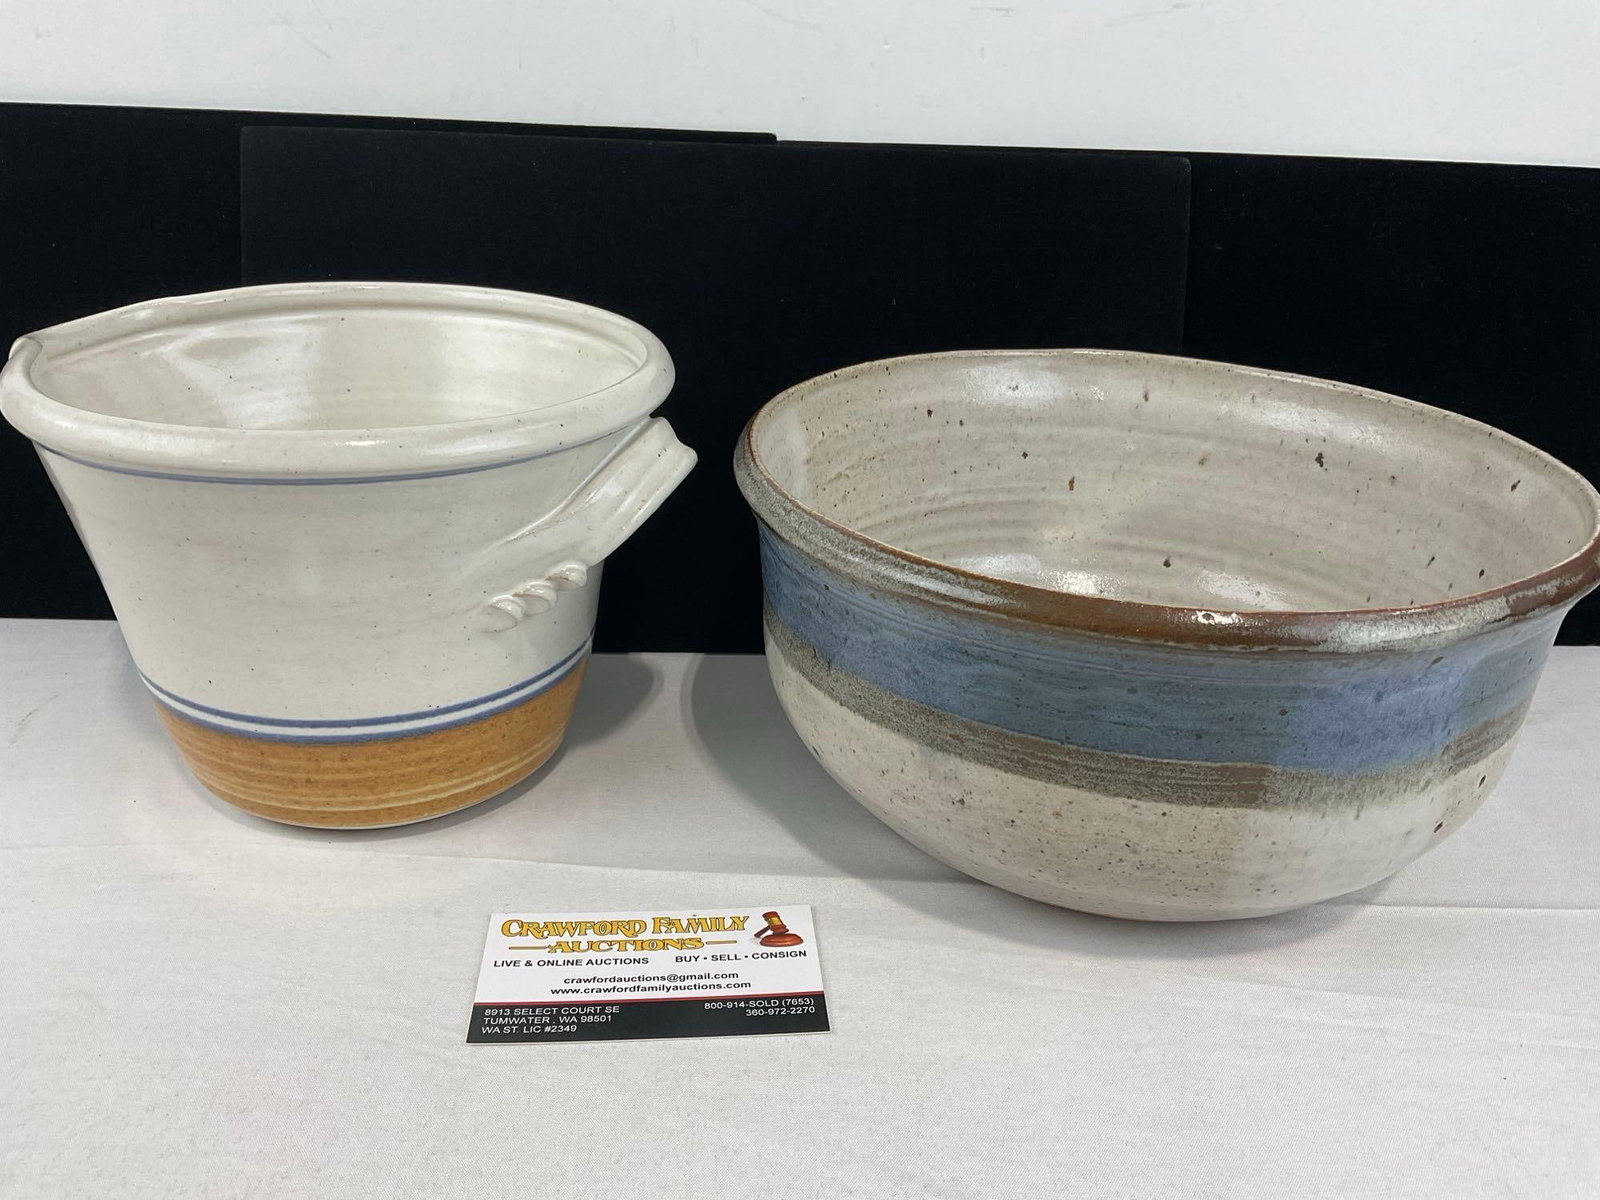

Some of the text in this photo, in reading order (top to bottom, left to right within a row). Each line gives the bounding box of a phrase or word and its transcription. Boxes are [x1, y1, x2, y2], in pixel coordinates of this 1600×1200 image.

[501, 916, 749, 939] CRAWFORD FAMILY
[547, 937, 705, 953] AUCTIONS
[494, 959, 521, 967] LIVE
[537, 959, 583, 967] ONLINE
[586, 957, 649, 966] AUCTIONS
[675, 950, 807, 963] BUY SELL CONSIGN
[563, 972, 739, 984] crawfordauctions@gmail.com
[550, 981, 752, 995] www.crawfordfamilyauctions.com
[704, 998, 815, 1009] 800-914-SOLD (7653)
[484, 1005, 620, 1016] 8913 SELECT COURT SE
[745, 1006, 816, 1017] 360-972-2270
[580, 1015, 613, 1023] 98501
[481, 1026, 500, 1034] WA
[523, 1025, 541, 1033] LIC
[544, 1025, 578, 1034] #2349
